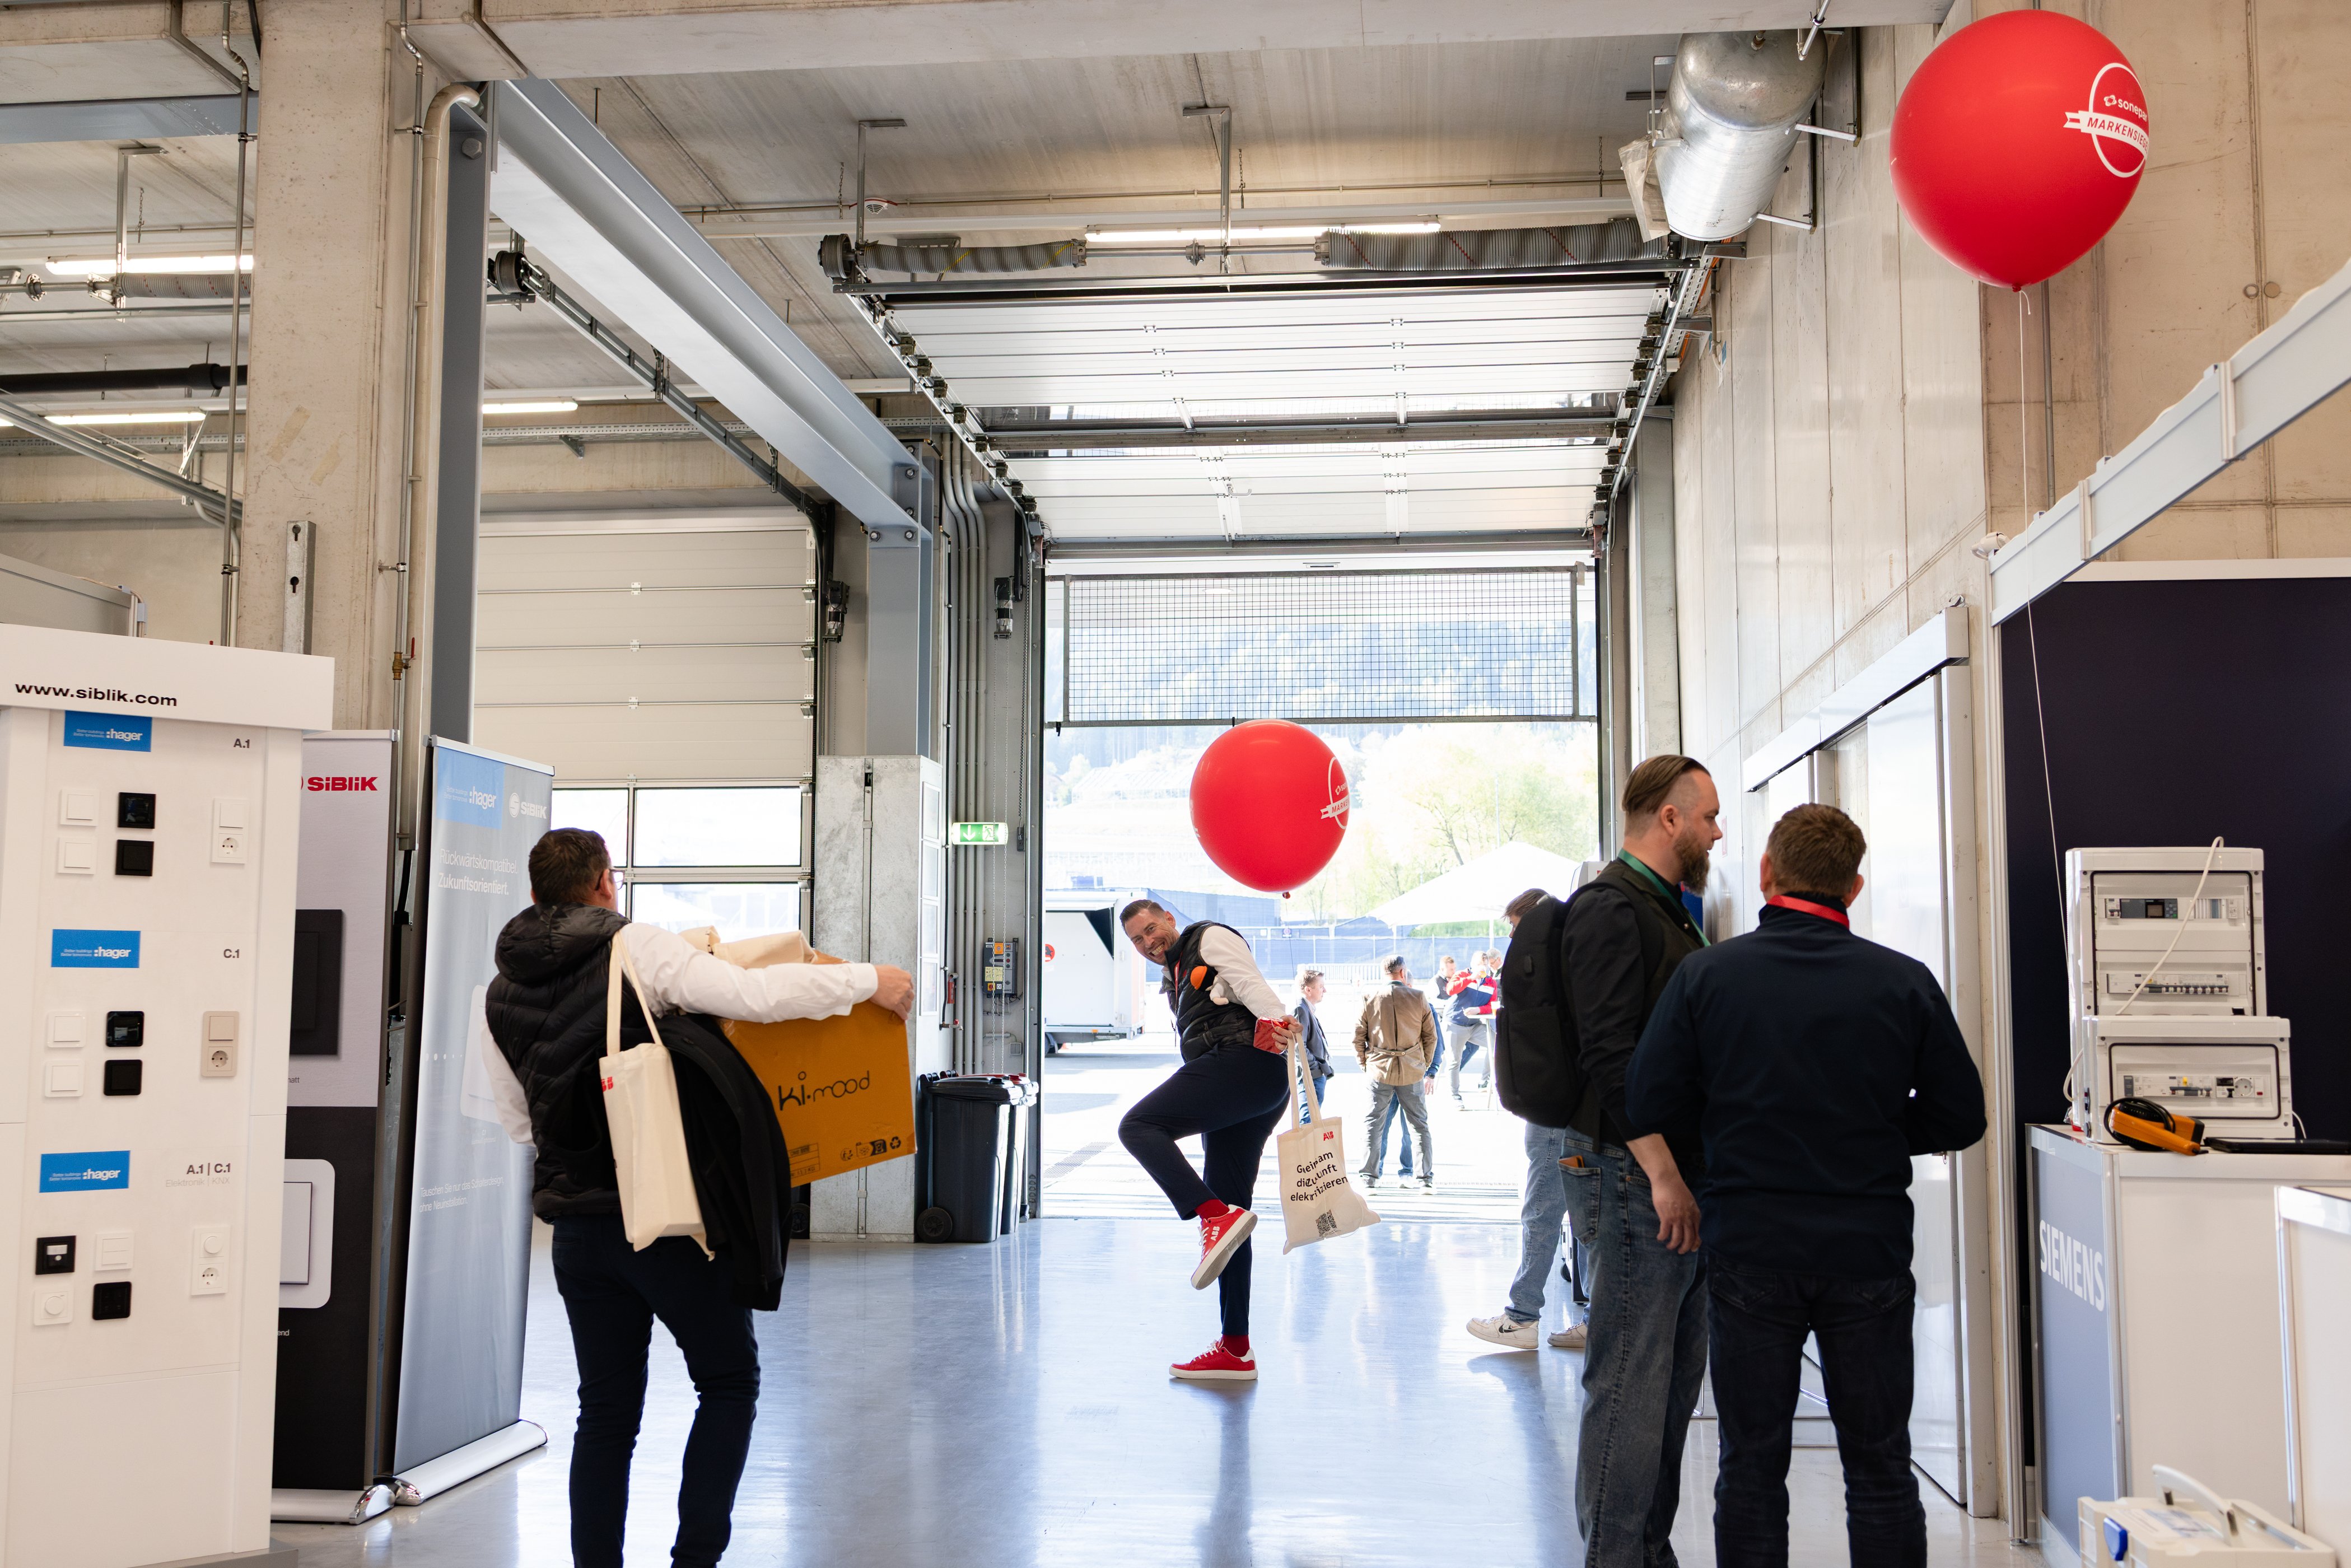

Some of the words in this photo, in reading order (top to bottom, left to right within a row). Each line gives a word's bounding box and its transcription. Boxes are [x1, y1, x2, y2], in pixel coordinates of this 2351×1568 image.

[2117, 99, 2147, 122] sonepar
[15, 684, 177, 707] www.siblik.com
[233, 738, 250, 749] A.1
[440, 848, 518, 874] Rückwärtskompatibel.
[437, 872, 509, 895] Zukunftsorientiert.
[223, 948, 240, 959] C.1
[186, 1164, 203, 1175] A.1
[214, 1163, 231, 1174] C.1
[166, 1178, 206, 1187] Elektronik
[212, 1177, 230, 1185] KNX
[420, 1186, 444, 1197] Tauschen
[461, 1181, 470, 1191] das
[471, 1175, 504, 1189] Schalterdesign,
[419, 1202, 432, 1212] ohne
[433, 1196, 468, 1210] Neuinstallation.
[1210, 1226, 1220, 1242] ABB
[2039, 1219, 2105, 1312] SIEMENS
